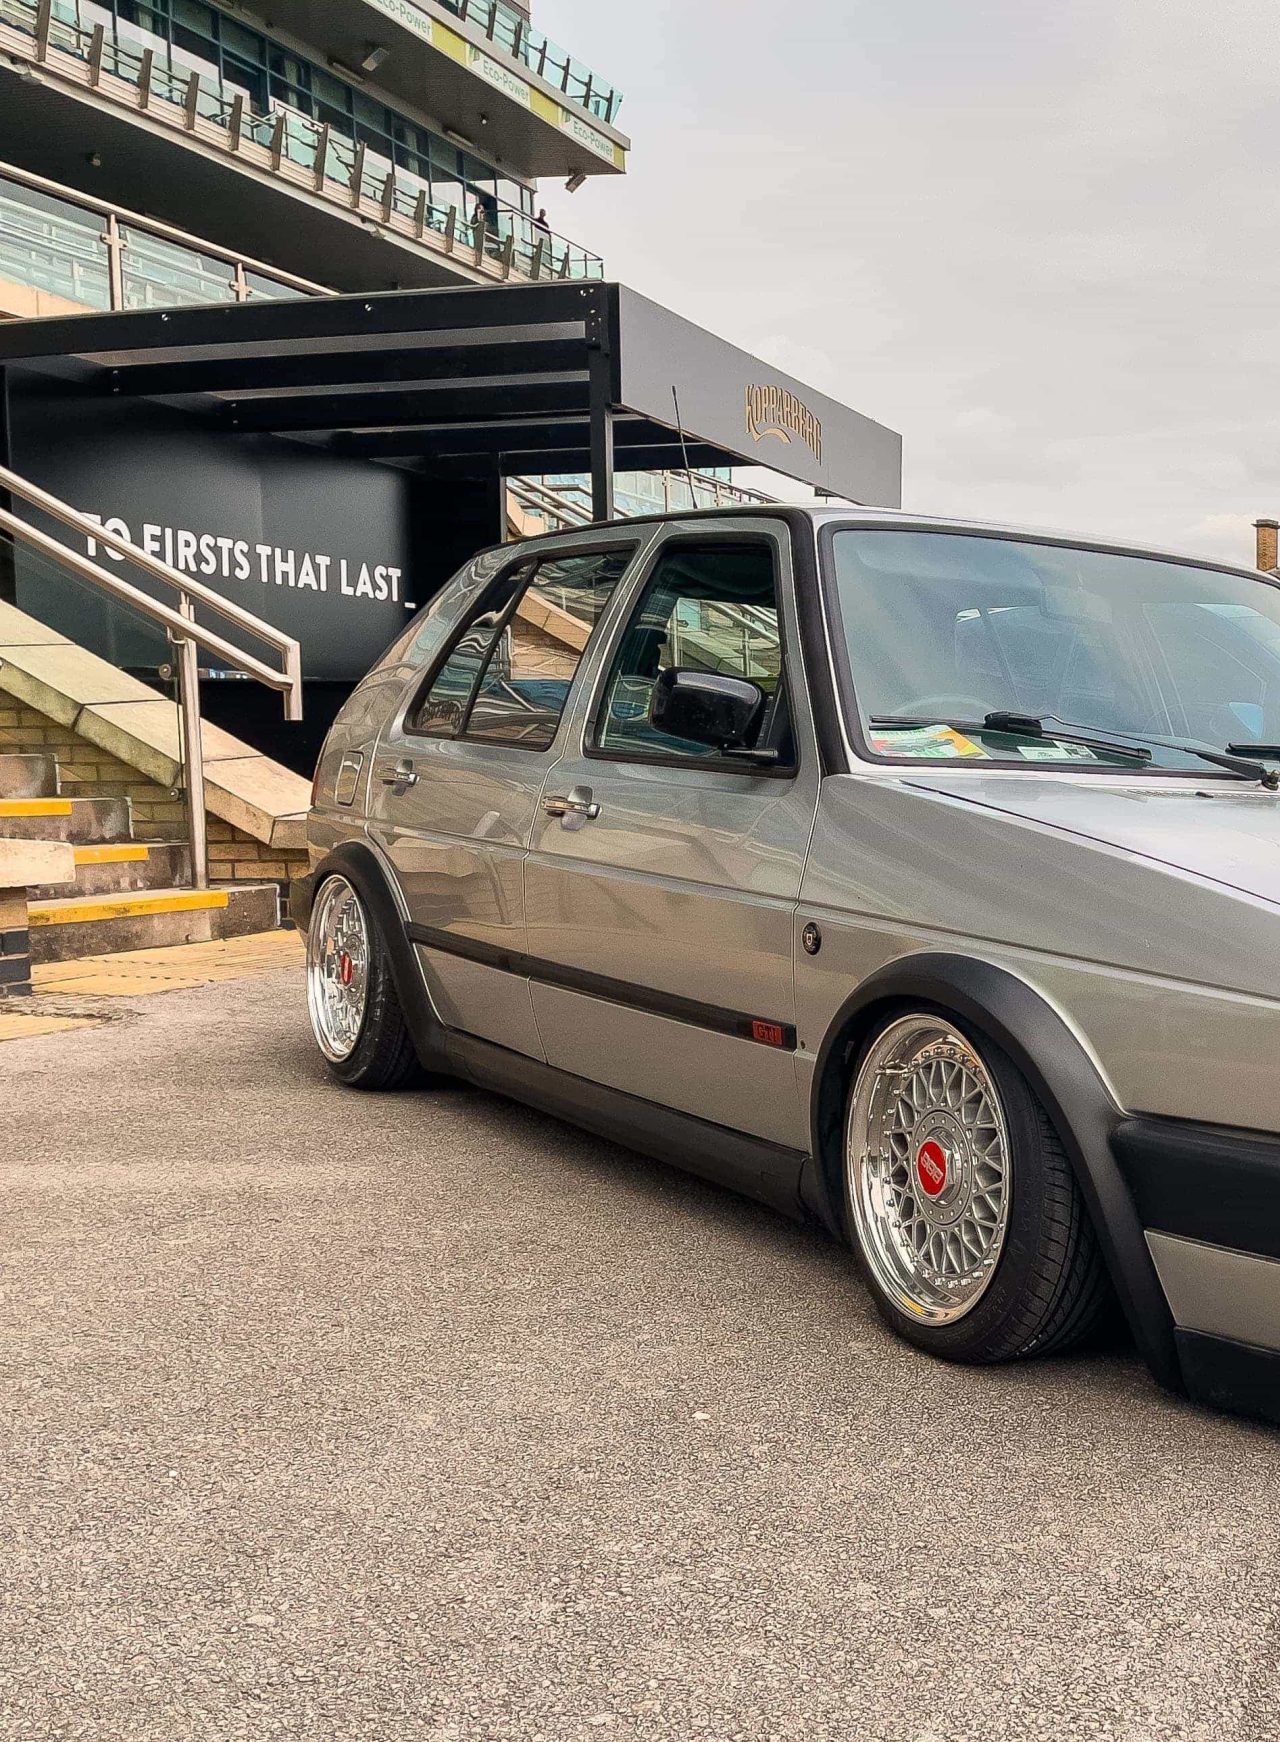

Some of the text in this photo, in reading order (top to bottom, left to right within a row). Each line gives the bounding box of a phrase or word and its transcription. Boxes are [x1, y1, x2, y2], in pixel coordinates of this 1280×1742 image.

[379, 0, 431, 36] co-Power
[483, 60, 529, 101] Eco-Power
[573, 121, 613, 157] Eco-Power
[745, 384, 822, 466] KOPPARBERG
[78, 512, 131, 561] TO
[142, 523, 250, 580] FIRSTS
[256, 543, 331, 591] THAT
